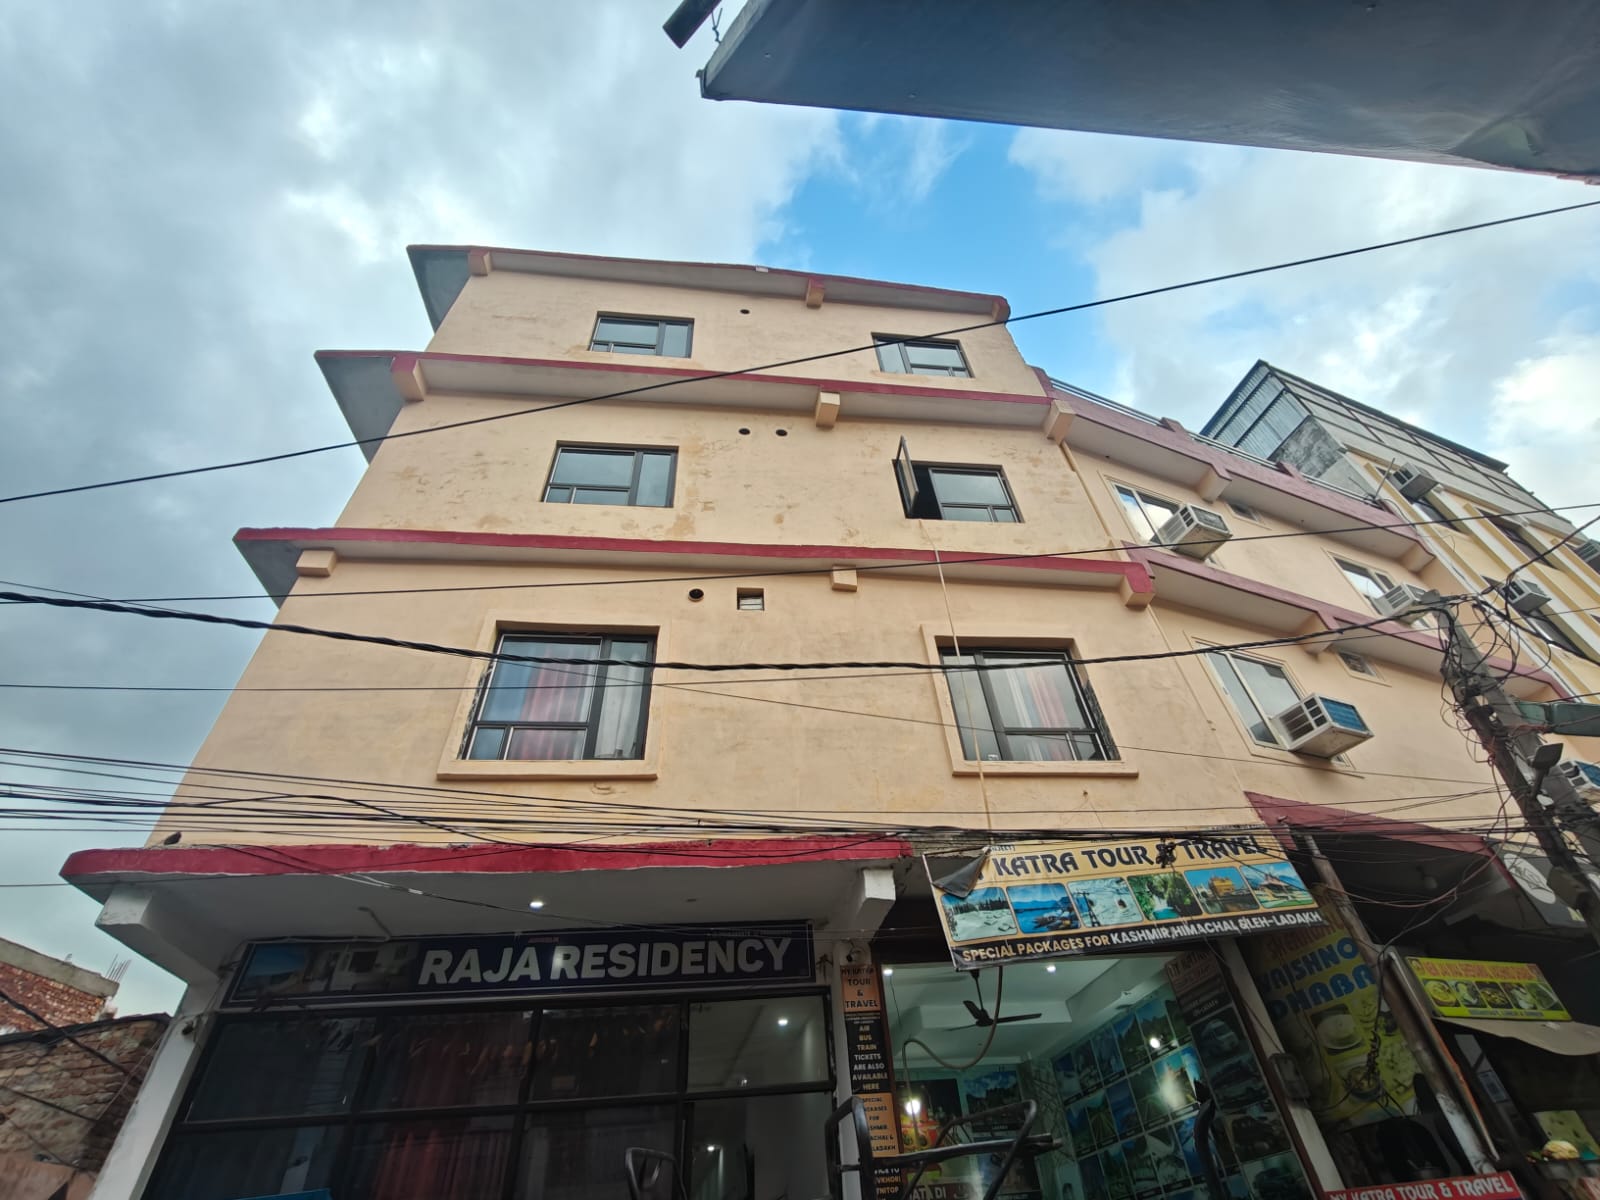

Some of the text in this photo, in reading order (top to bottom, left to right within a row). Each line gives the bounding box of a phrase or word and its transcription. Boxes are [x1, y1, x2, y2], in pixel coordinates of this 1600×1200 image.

[992, 852, 1079, 877] KATRA
[1081, 845, 1154, 869] TOUR
[1175, 834, 1268, 860] TRAVEL
[962, 944, 1017, 962] SPECIAL
[1016, 937, 1085, 955] PACKAGES
[1085, 935, 1111, 948] FOR
[1249, 910, 1322, 930] LEH-LADAKH
[417, 937, 793, 985] RAJA RESIDENCY
[1257, 936, 1359, 994] VAISHNO
[847, 978, 871, 986] TOUR
[1269, 963, 1377, 1019] DHABA
[845, 1000, 878, 1009] TRAVEL
[854, 1053, 881, 1061] TICKETS
[852, 1072, 888, 1081] AVAILABLE
[1395, 1182, 1439, 1200] TOUR
[1440, 1180, 1452, 1198] &
[1453, 1175, 1513, 1197] TRAVEL
